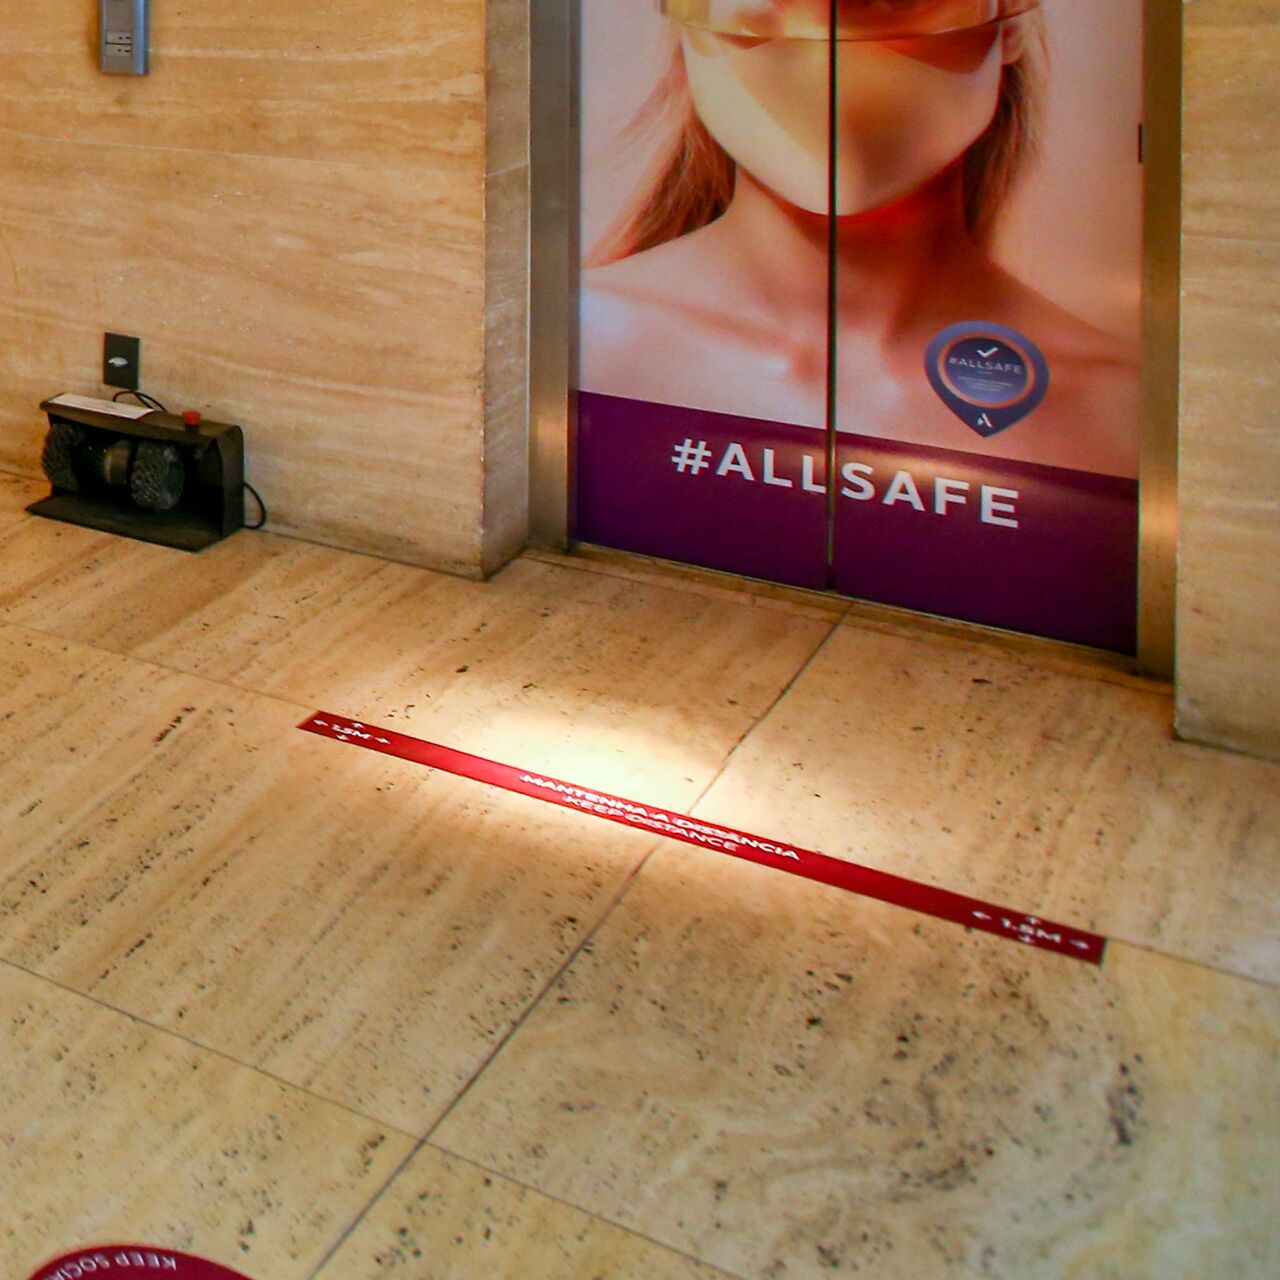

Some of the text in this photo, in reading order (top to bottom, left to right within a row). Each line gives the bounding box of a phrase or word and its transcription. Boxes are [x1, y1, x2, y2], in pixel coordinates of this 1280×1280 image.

[670, 437, 1020, 529] #ALLSAFE
[520, 773, 649, 816] MANTENHA
[650, 812, 671, 824] A
[563, 795, 740, 852] KEEP DISTANCE
[1001, 917, 1062, 944] 1.5M
[113, 1251, 177, 1271] KEEP
